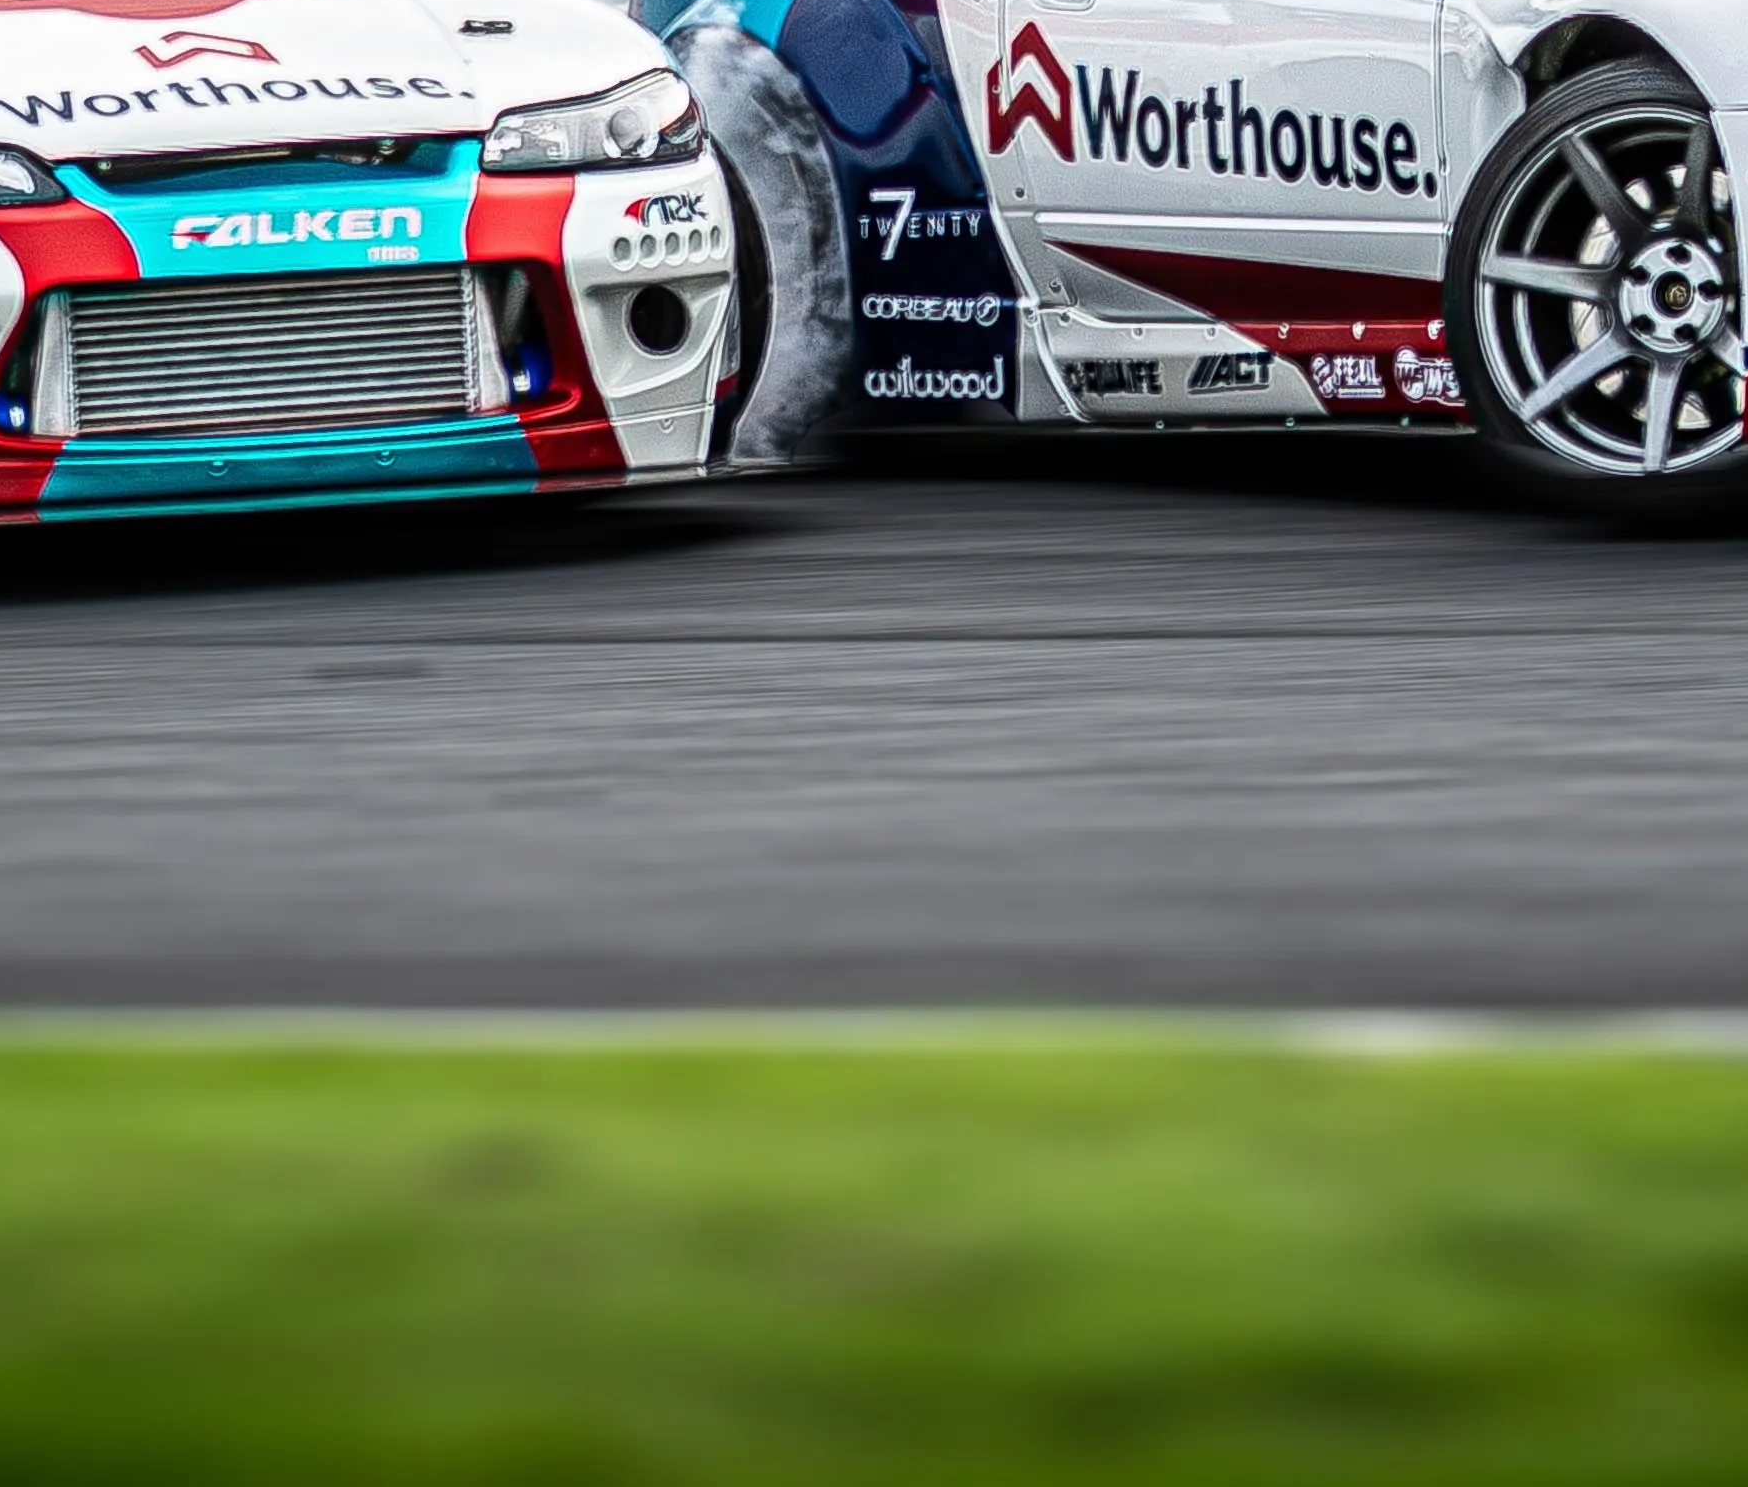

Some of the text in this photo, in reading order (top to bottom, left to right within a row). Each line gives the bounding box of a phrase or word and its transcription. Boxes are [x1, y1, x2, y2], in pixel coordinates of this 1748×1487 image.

[1072, 63, 1438, 199] Worthouse.
[168, 207, 422, 250] FALKEN
[869, 187, 916, 260] 7
